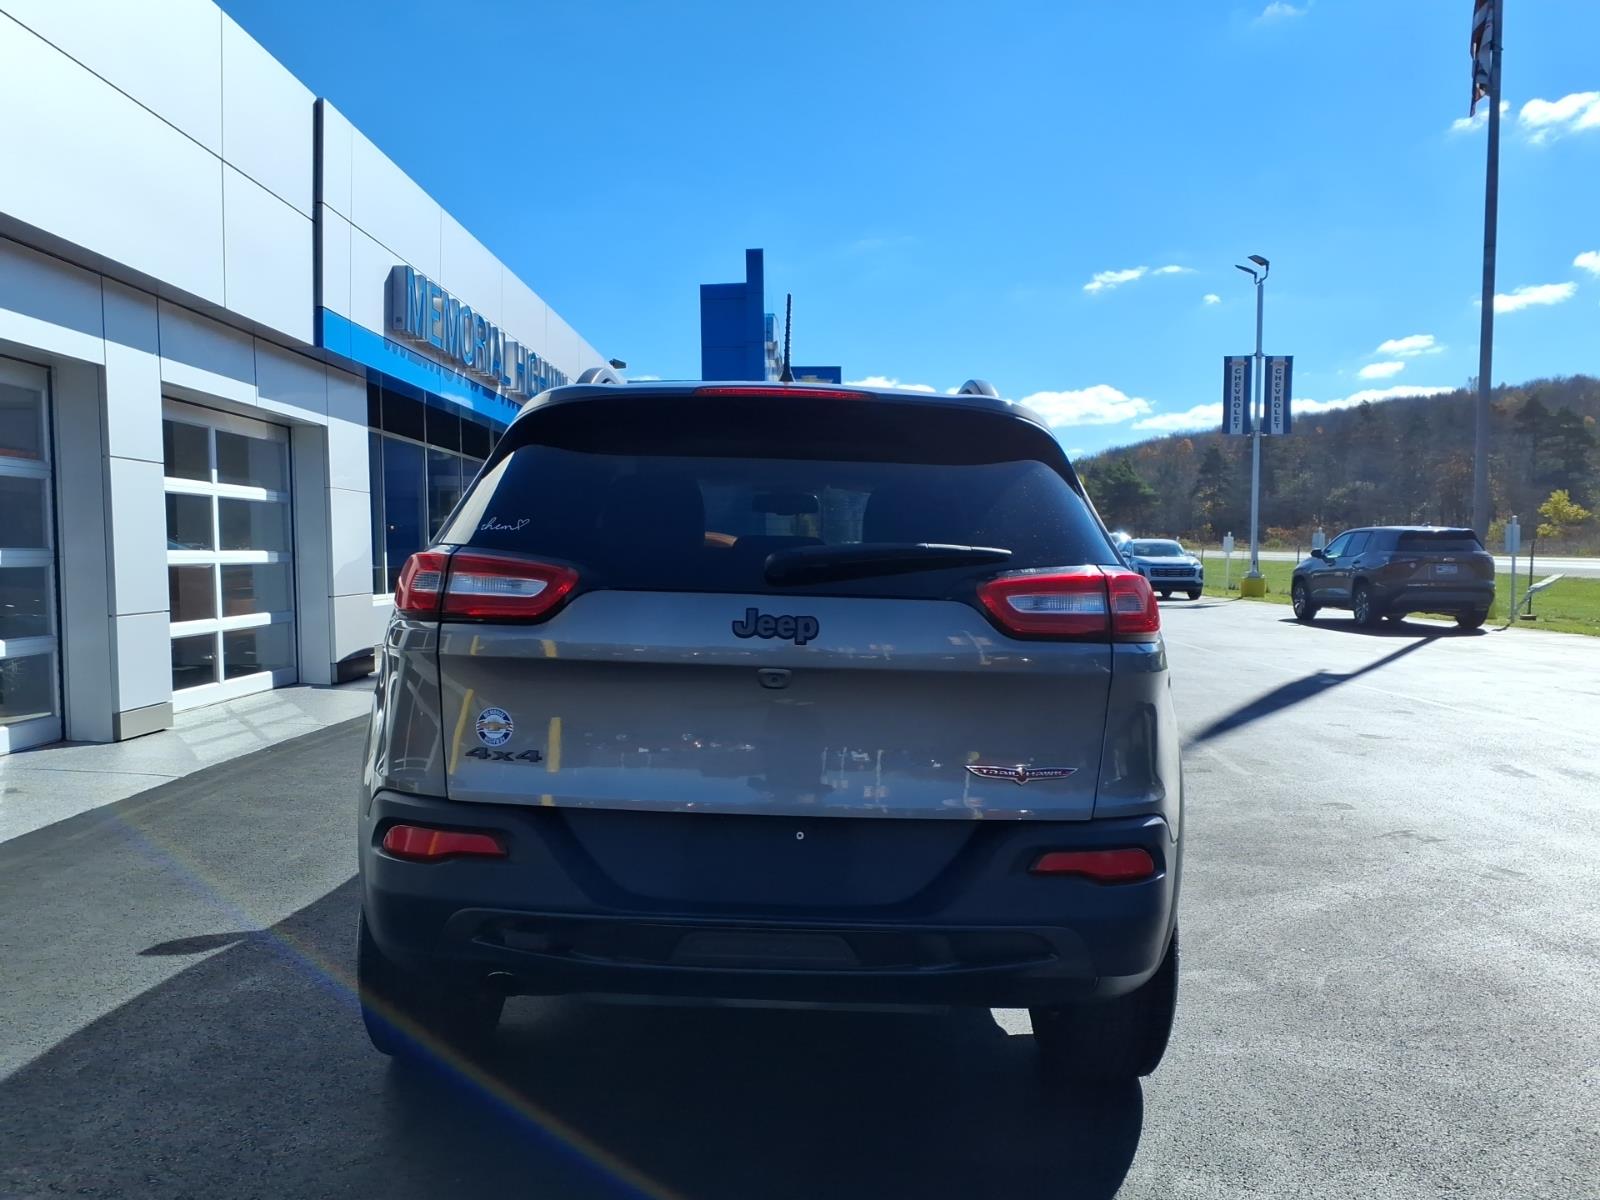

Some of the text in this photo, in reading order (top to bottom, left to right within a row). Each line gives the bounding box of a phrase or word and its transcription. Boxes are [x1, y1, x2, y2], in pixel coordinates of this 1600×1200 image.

[385, 265, 511, 388] MEMORIAL
[1233, 368, 1242, 430] CHEVROLET
[732, 607, 819, 646] Jeep
